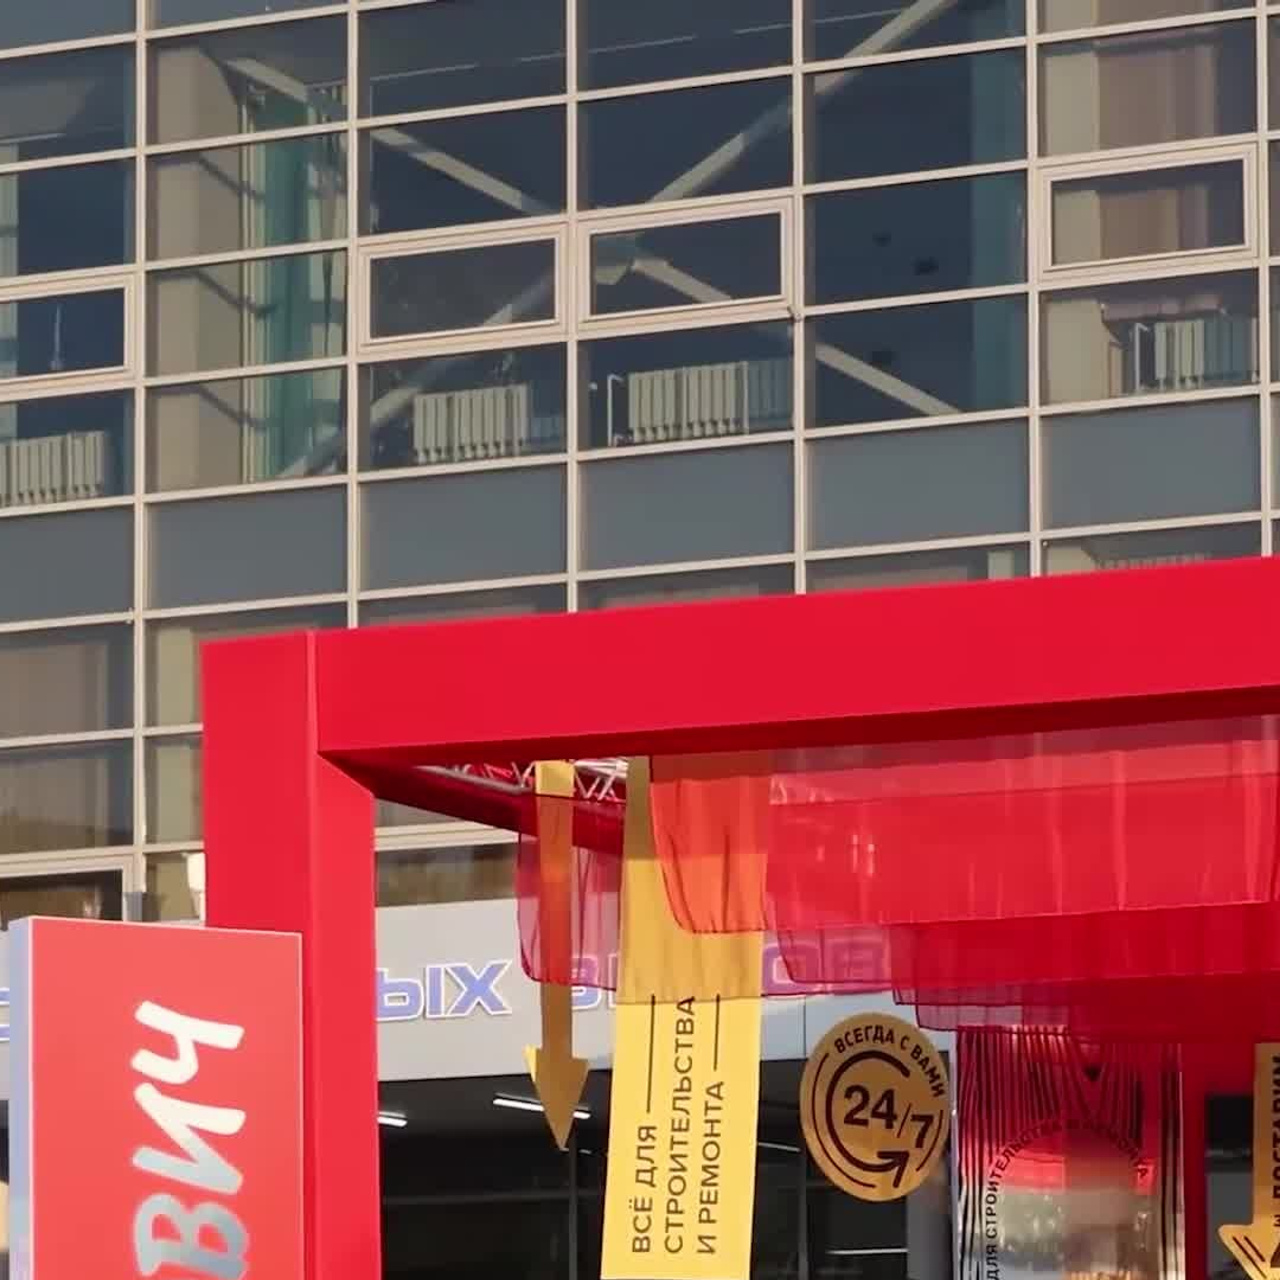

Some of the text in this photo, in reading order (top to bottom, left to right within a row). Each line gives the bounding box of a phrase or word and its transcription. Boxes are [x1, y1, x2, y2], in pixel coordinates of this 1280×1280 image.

[664, 996, 696, 1254] СТРОИТЕЛЬСТВА
[834, 1025, 946, 1098] ВСЕГДА С ВАМИ
[843, 1084, 934, 1149] 24/7
[629, 1125, 657, 1253] ВСЁ ДЛЯ
[696, 1081, 724, 1254] И РЕМОНТА
